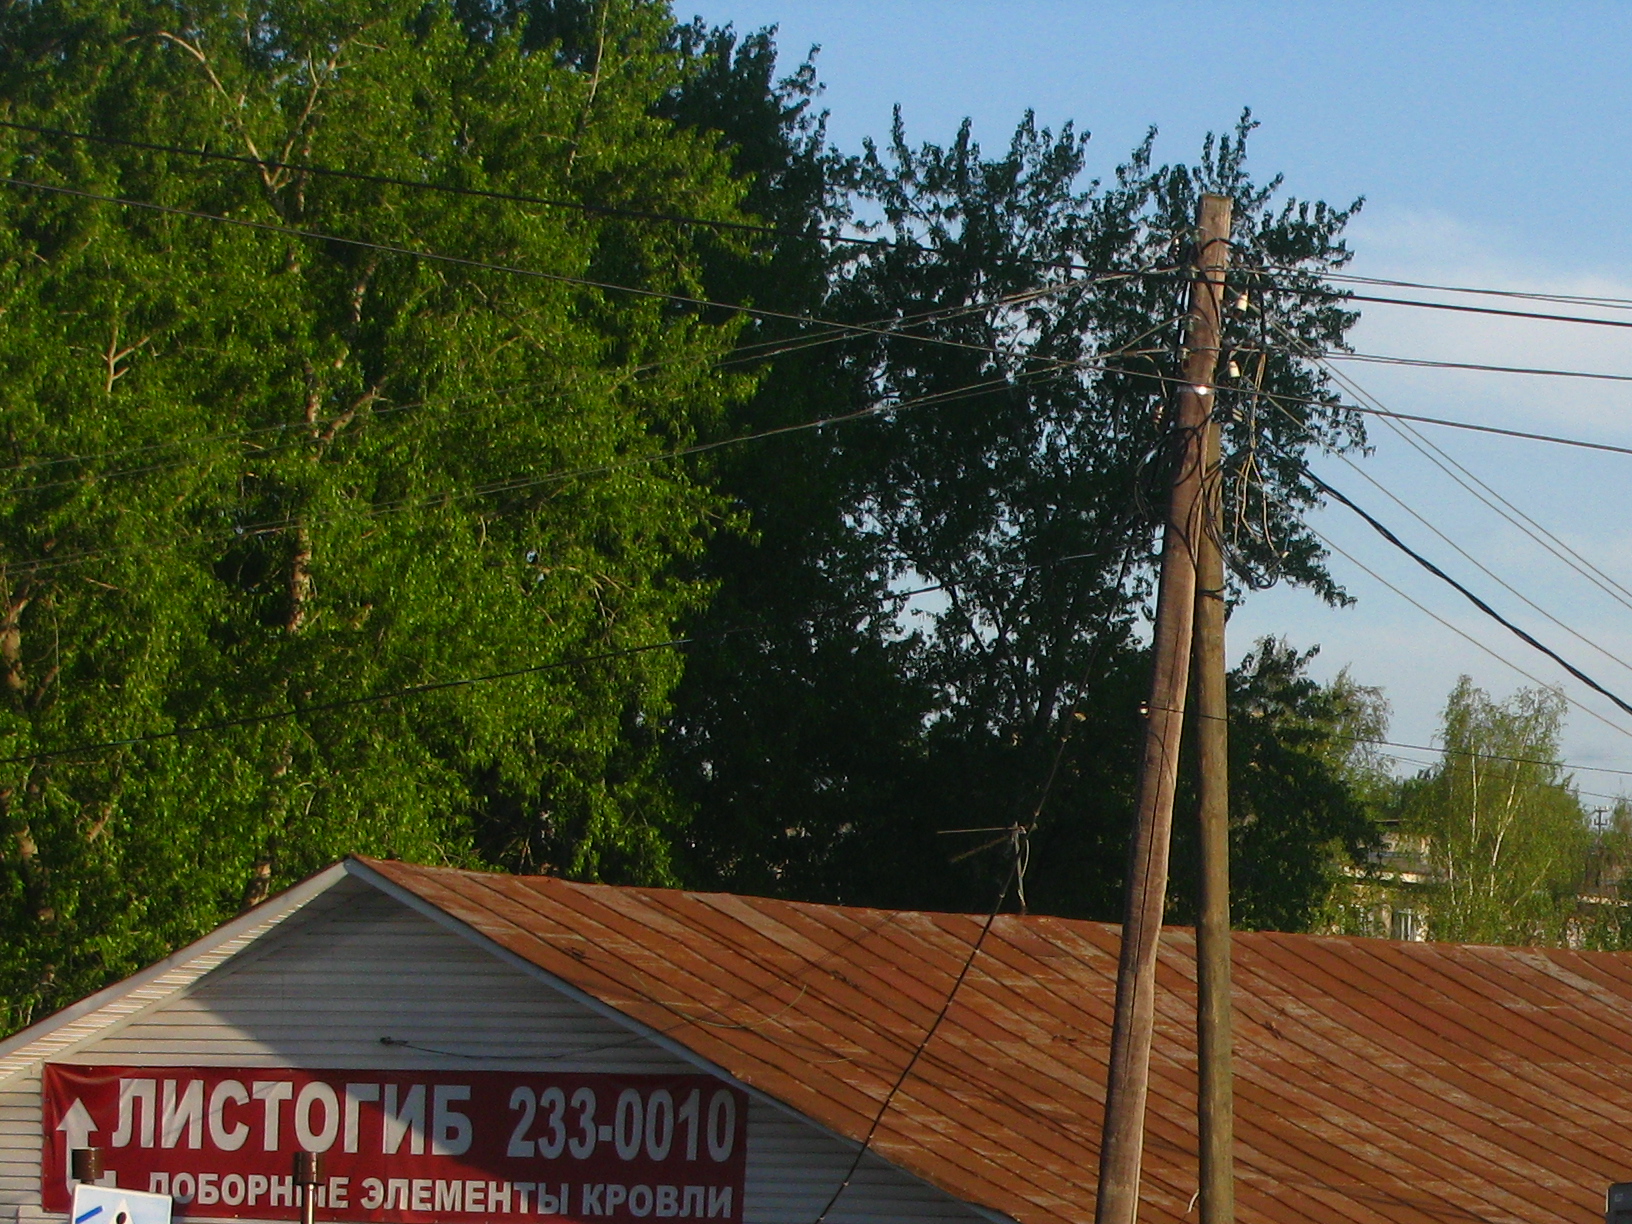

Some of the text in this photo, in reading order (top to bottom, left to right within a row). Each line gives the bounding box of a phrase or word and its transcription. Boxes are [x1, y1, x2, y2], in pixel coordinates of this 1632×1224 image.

[112, 1078, 737, 1163] ЛИСТОГИБ 233-0010
[361, 1177, 569, 1216] ЭЛЕМЕНТЫ
[582, 1183, 733, 1219] КРОВЛИ
